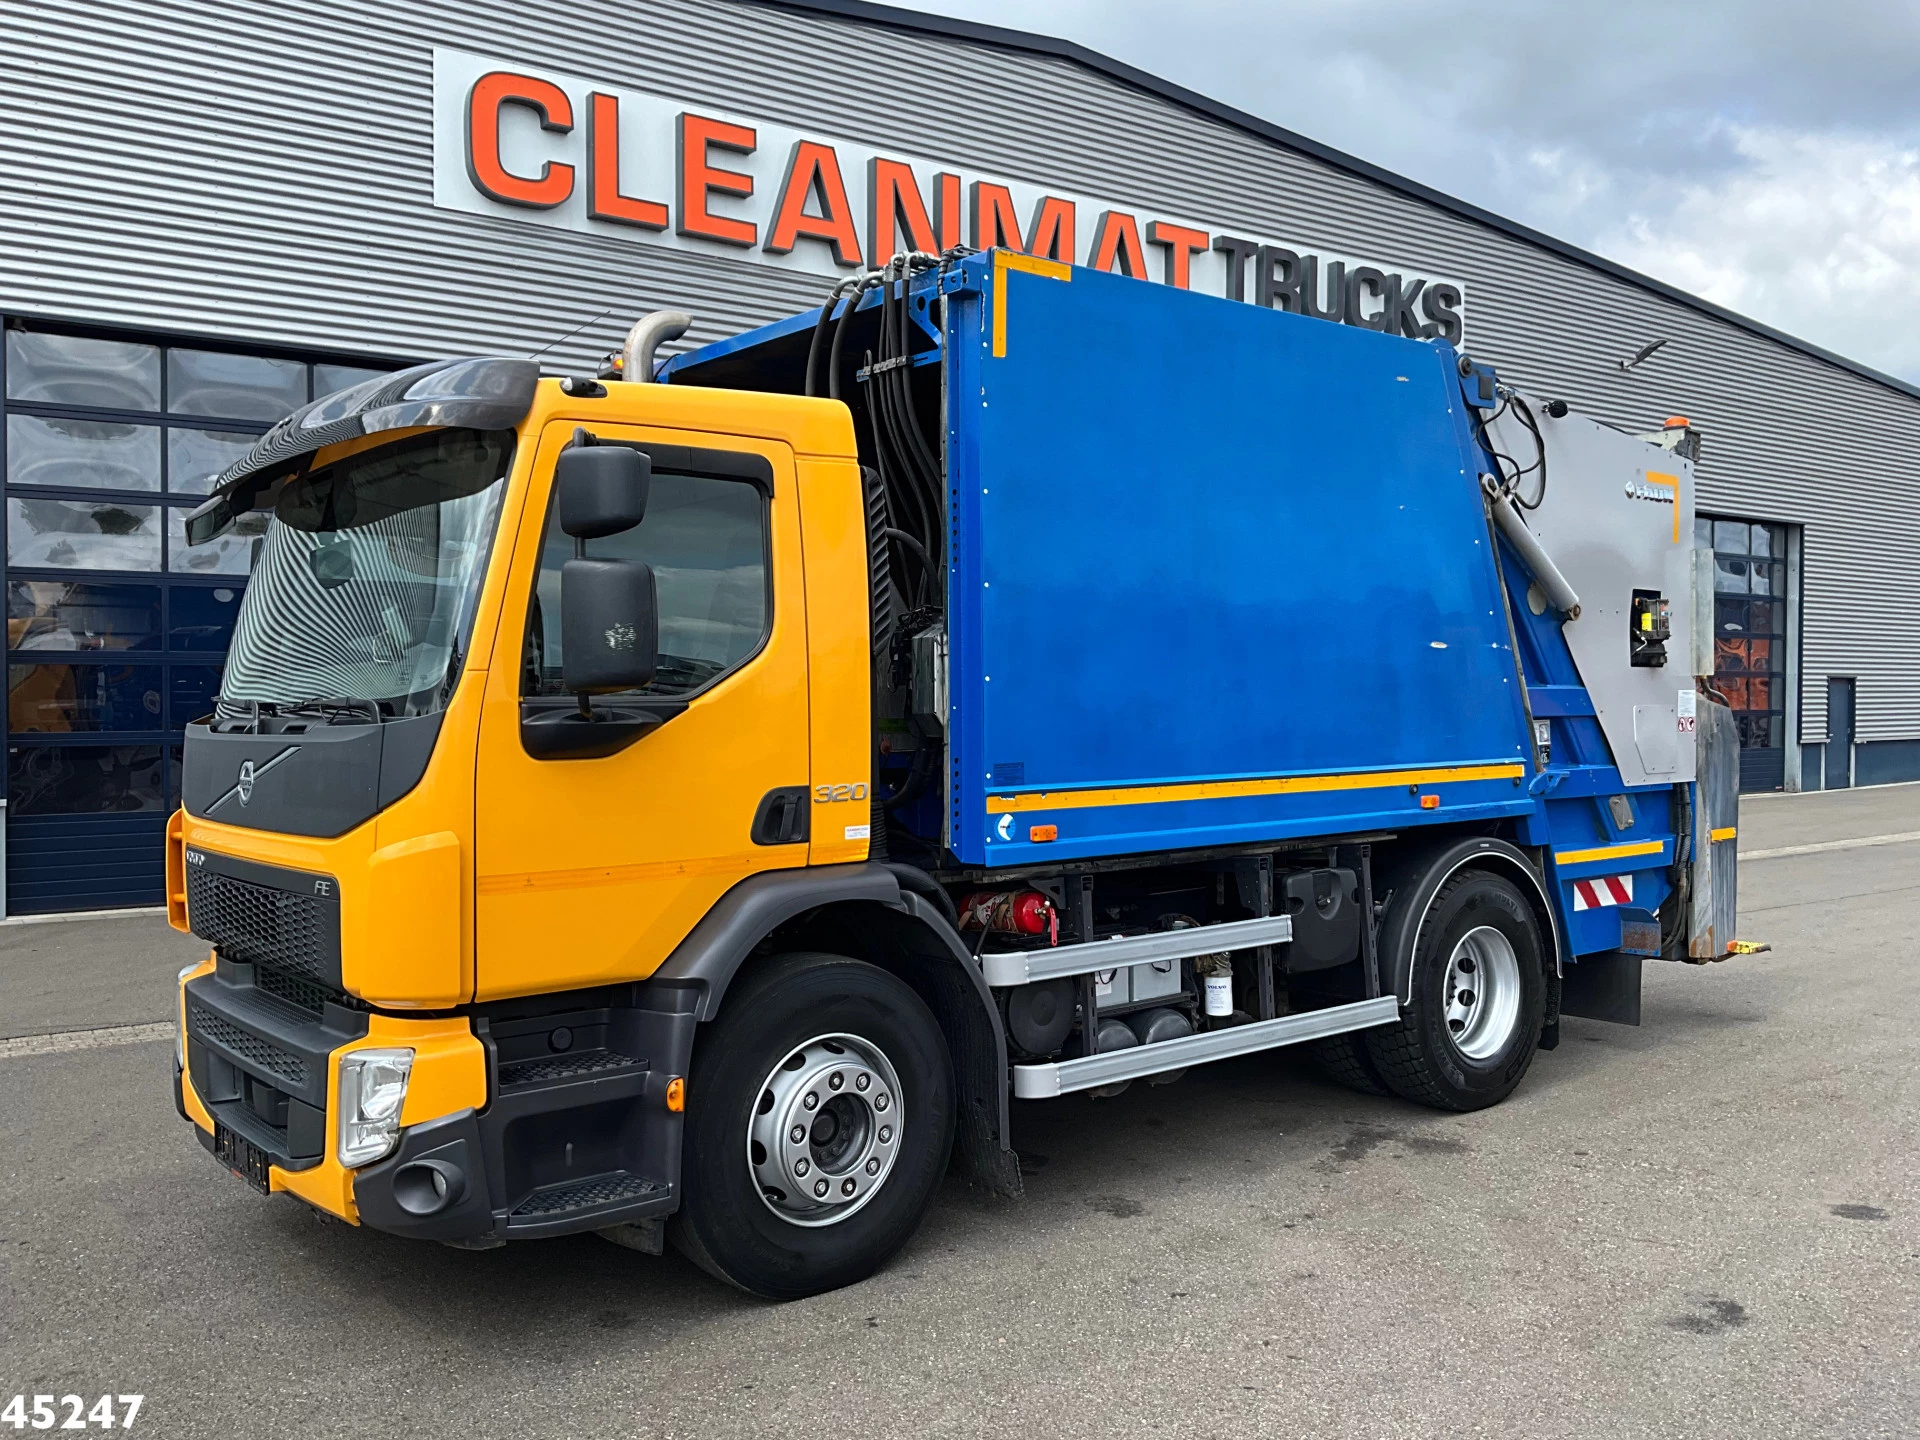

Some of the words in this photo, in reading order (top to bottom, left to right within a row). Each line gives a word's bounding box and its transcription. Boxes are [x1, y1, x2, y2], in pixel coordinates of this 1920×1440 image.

[465, 70, 1209, 290] CLEANMAT
[1213, 235, 1463, 346] TRUCKS
[814, 782, 868, 803] 320
[314, 880, 331, 896] FE
